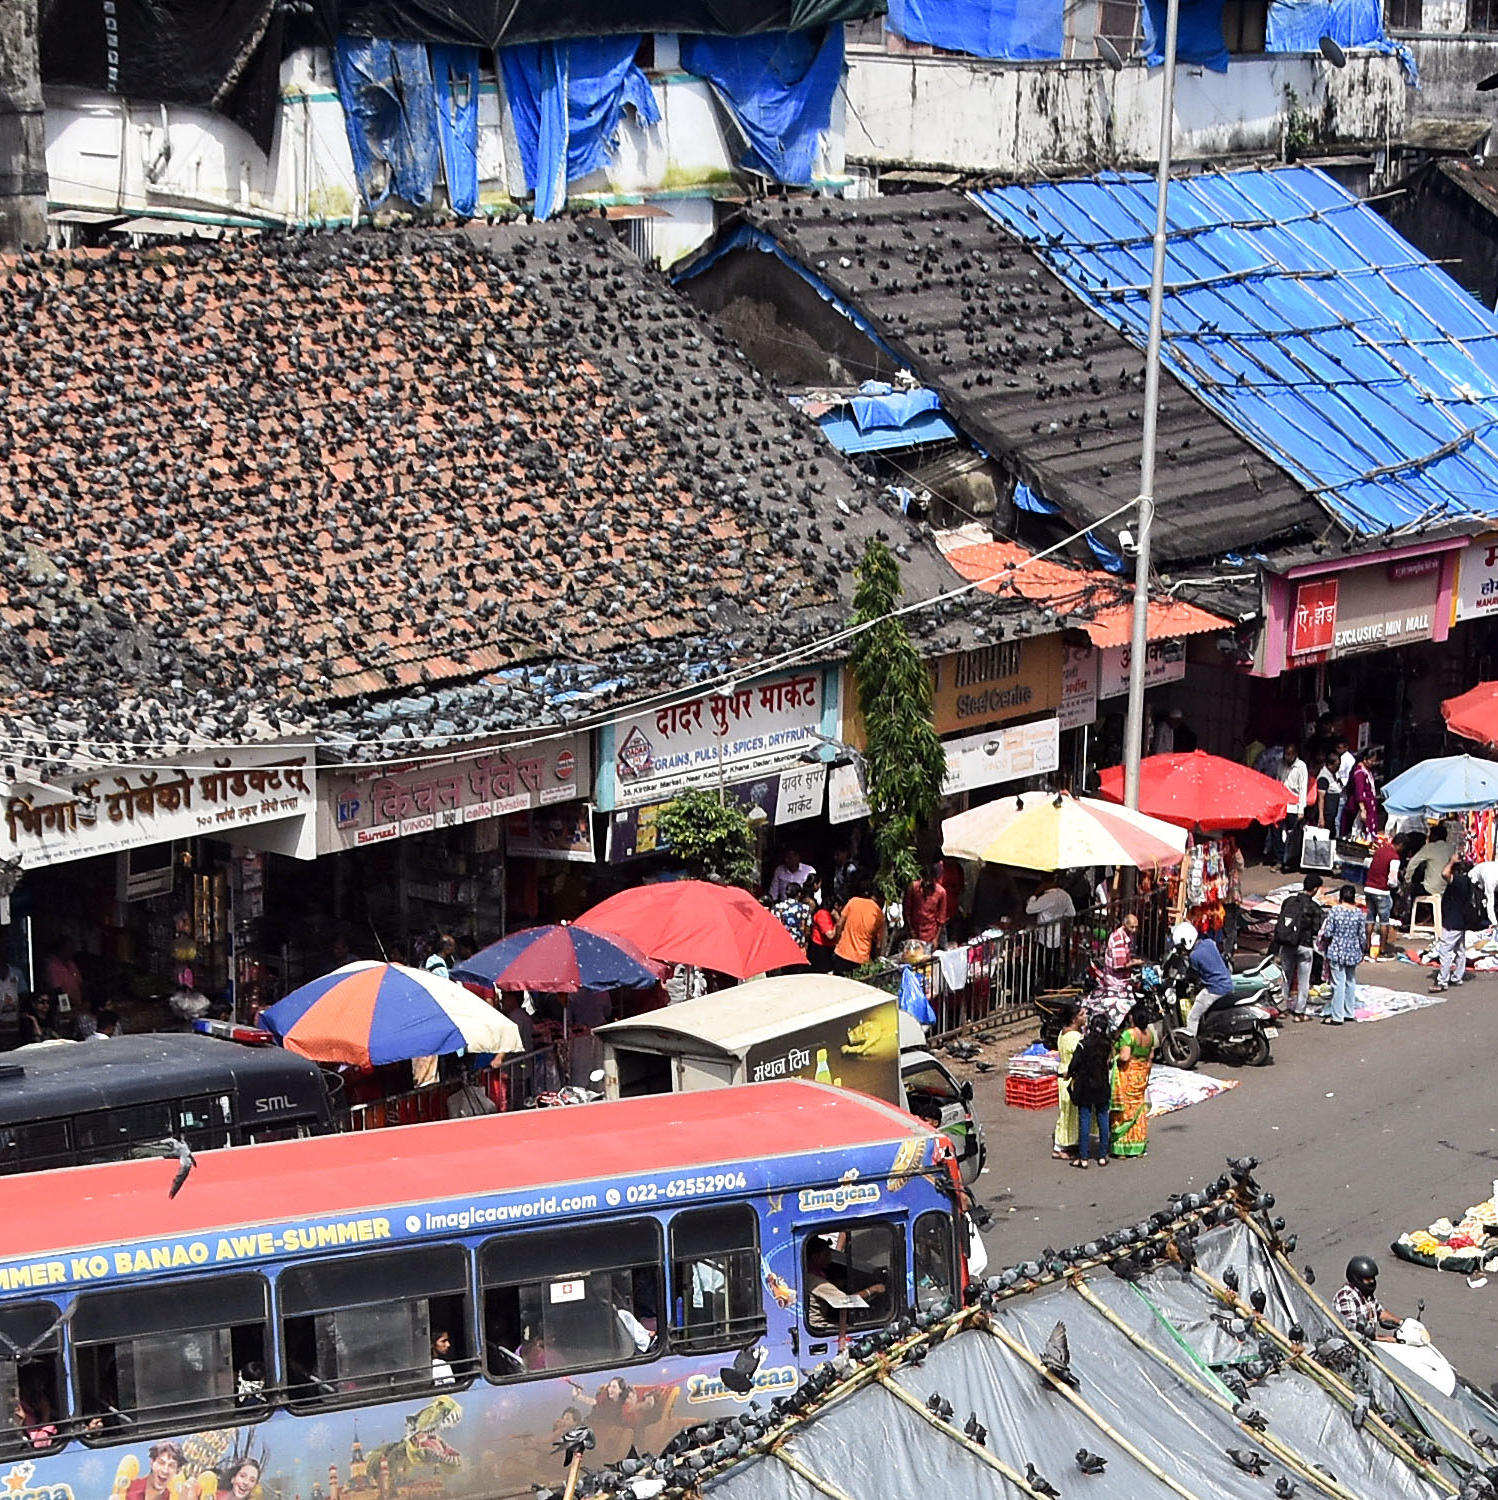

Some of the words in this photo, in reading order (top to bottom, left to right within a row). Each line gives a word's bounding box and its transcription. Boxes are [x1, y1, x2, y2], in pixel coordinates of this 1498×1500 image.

[1335, 624, 1383, 647] EXCLUSIVE
[1405, 614, 1429, 632] MALL
[654, 698, 706, 739] दादर
[708, 688, 753, 736] सुपर
[758, 674, 818, 714] मार्केट
[956, 691, 990, 719] Steel
[990, 684, 1033, 711] Centre
[654, 751, 694, 772] GRAINS,
[733, 735, 768, 760] SPICES,
[370, 772, 467, 826] किचन
[468, 753, 546, 802] पॅलेस
[781, 771, 803, 793] दादर
[805, 768, 825, 789] सुपर
[466, 805, 492, 820] cello
[787, 795, 813, 815] मार्केट
[357, 823, 398, 844] Sumeet
[403, 816, 434, 833] VINOD
[753, 1057, 787, 1085] मंथन
[787, 1046, 811, 1072] दिप
[256, 1095, 297, 1113] SML
[626, 1172, 747, 1204] 022-62552904
[801, 1183, 877, 1208] Imagicaa
[426, 1193, 597, 1232] imagicaaworld.com
[72, 1255, 109, 1281] KO
[114, 1242, 209, 1274] BANAO
[216, 1216, 391, 1262] AWE-SUMMER
